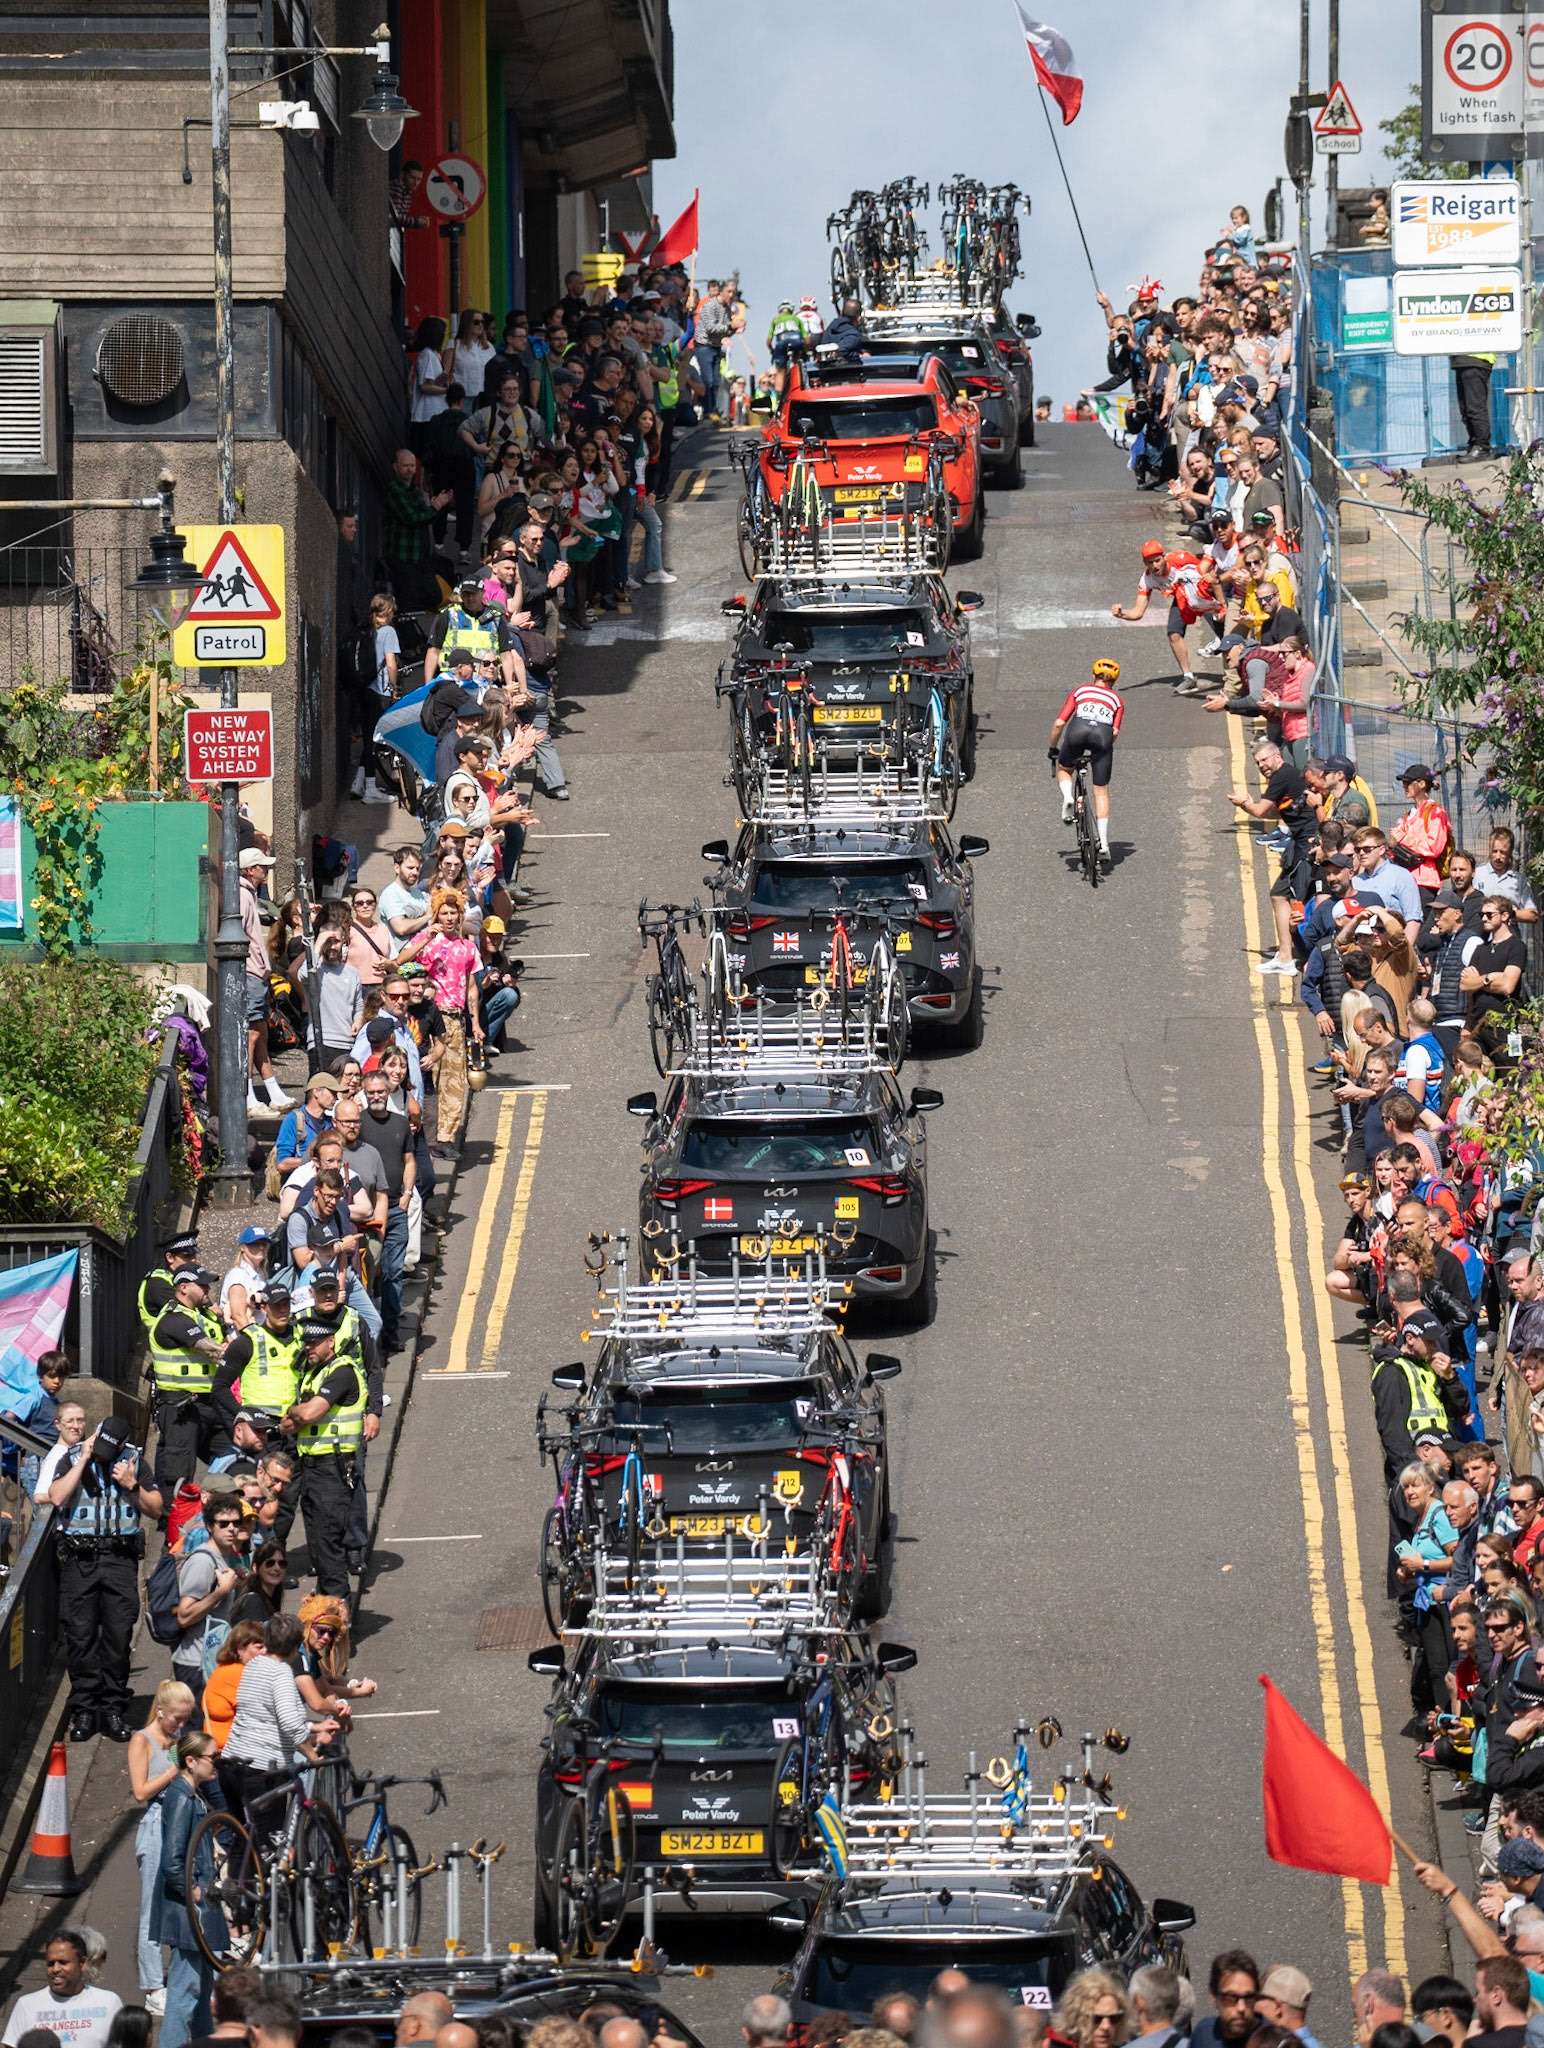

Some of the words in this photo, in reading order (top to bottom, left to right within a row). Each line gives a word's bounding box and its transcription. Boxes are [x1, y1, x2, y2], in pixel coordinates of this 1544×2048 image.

[1456, 43, 1502, 70] 20
[1460, 98, 1497, 108] When
[1440, 112, 1478, 125] lights
[1483, 112, 1516, 122] flash
[1321, 139, 1356, 148] School
[1432, 194, 1516, 220] Reigart
[1429, 224, 1444, 233] EST
[1429, 230, 1473, 248] 1988
[1401, 295, 1463, 316] Lyndon
[1474, 295, 1511, 311] SGB
[1344, 320, 1390, 330] EMERGENCY
[1348, 329, 1366, 337] EXIT
[1366, 328, 1386, 336] ONLY
[203, 635, 257, 649] Patrol
[912, 635, 918, 643] 7
[846, 692, 865, 701] Vardy
[818, 706, 850, 720] SM23
[853, 704, 876, 718] BZU
[1083, 704, 1095, 713] 62
[1099, 707, 1110, 718] 62
[210, 716, 248, 728] NEW
[193, 730, 266, 744] ONE-WAY
[199, 745, 260, 759] SYSTEM
[202, 760, 257, 773] AHEAD
[897, 937, 908, 945] 07
[848, 1151, 863, 1162] 10
[757, 1219, 779, 1228] Peer
[270, 1286, 287, 1295] POLICE
[100, 1432, 119, 1446] POLICE
[689, 1494, 712, 1504] Peter
[714, 1493, 740, 1504] Vardy
[776, 1722, 795, 1735] 13
[682, 1809, 709, 1821] Peter
[711, 1809, 739, 1822] Vardy
[669, 1834, 715, 1850] SM23
[720, 1833, 755, 1849] BZT
[1025, 1991, 1049, 2004] 22
[52, 2019, 93, 2031] ANGELES
